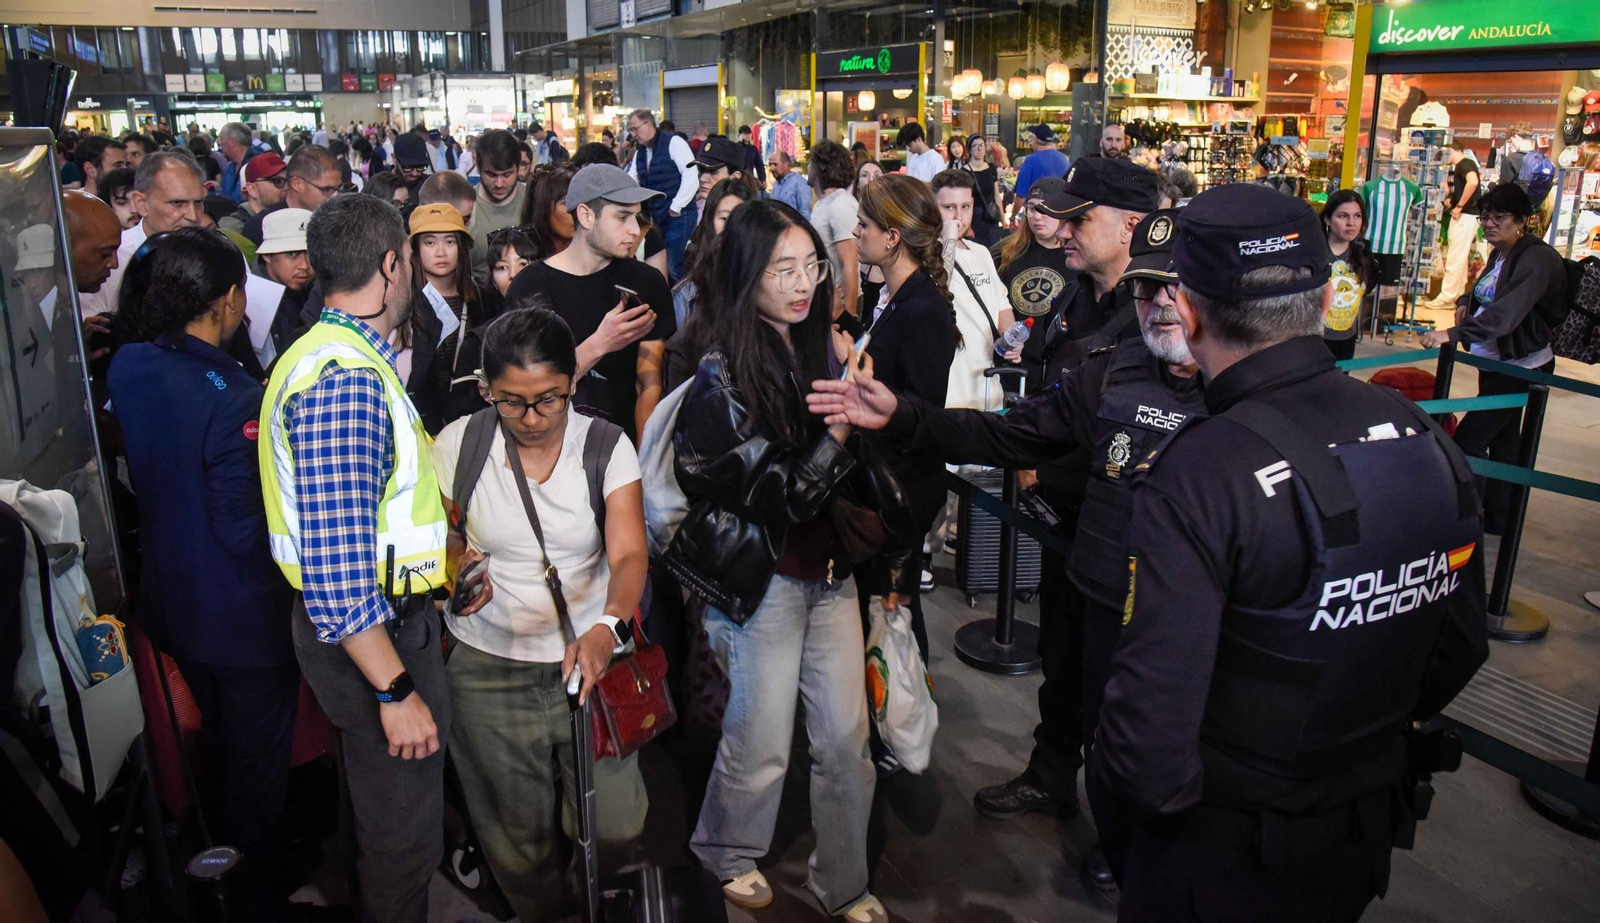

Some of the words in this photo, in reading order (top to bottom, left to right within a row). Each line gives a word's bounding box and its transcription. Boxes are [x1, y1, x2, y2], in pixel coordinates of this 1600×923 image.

[1378, 9, 1464, 45] discover
[1468, 21, 1552, 40] ANDALUCÍA
[839, 55, 876, 73] natura
[1240, 240, 1300, 256] NACIONAL
[969, 272, 990, 287] Ford
[1016, 270, 1061, 288] DELLAFUENTE
[1254, 460, 1292, 498] F
[1319, 550, 1449, 607] POLICÍA
[1309, 571, 1461, 631] NACIONAL
